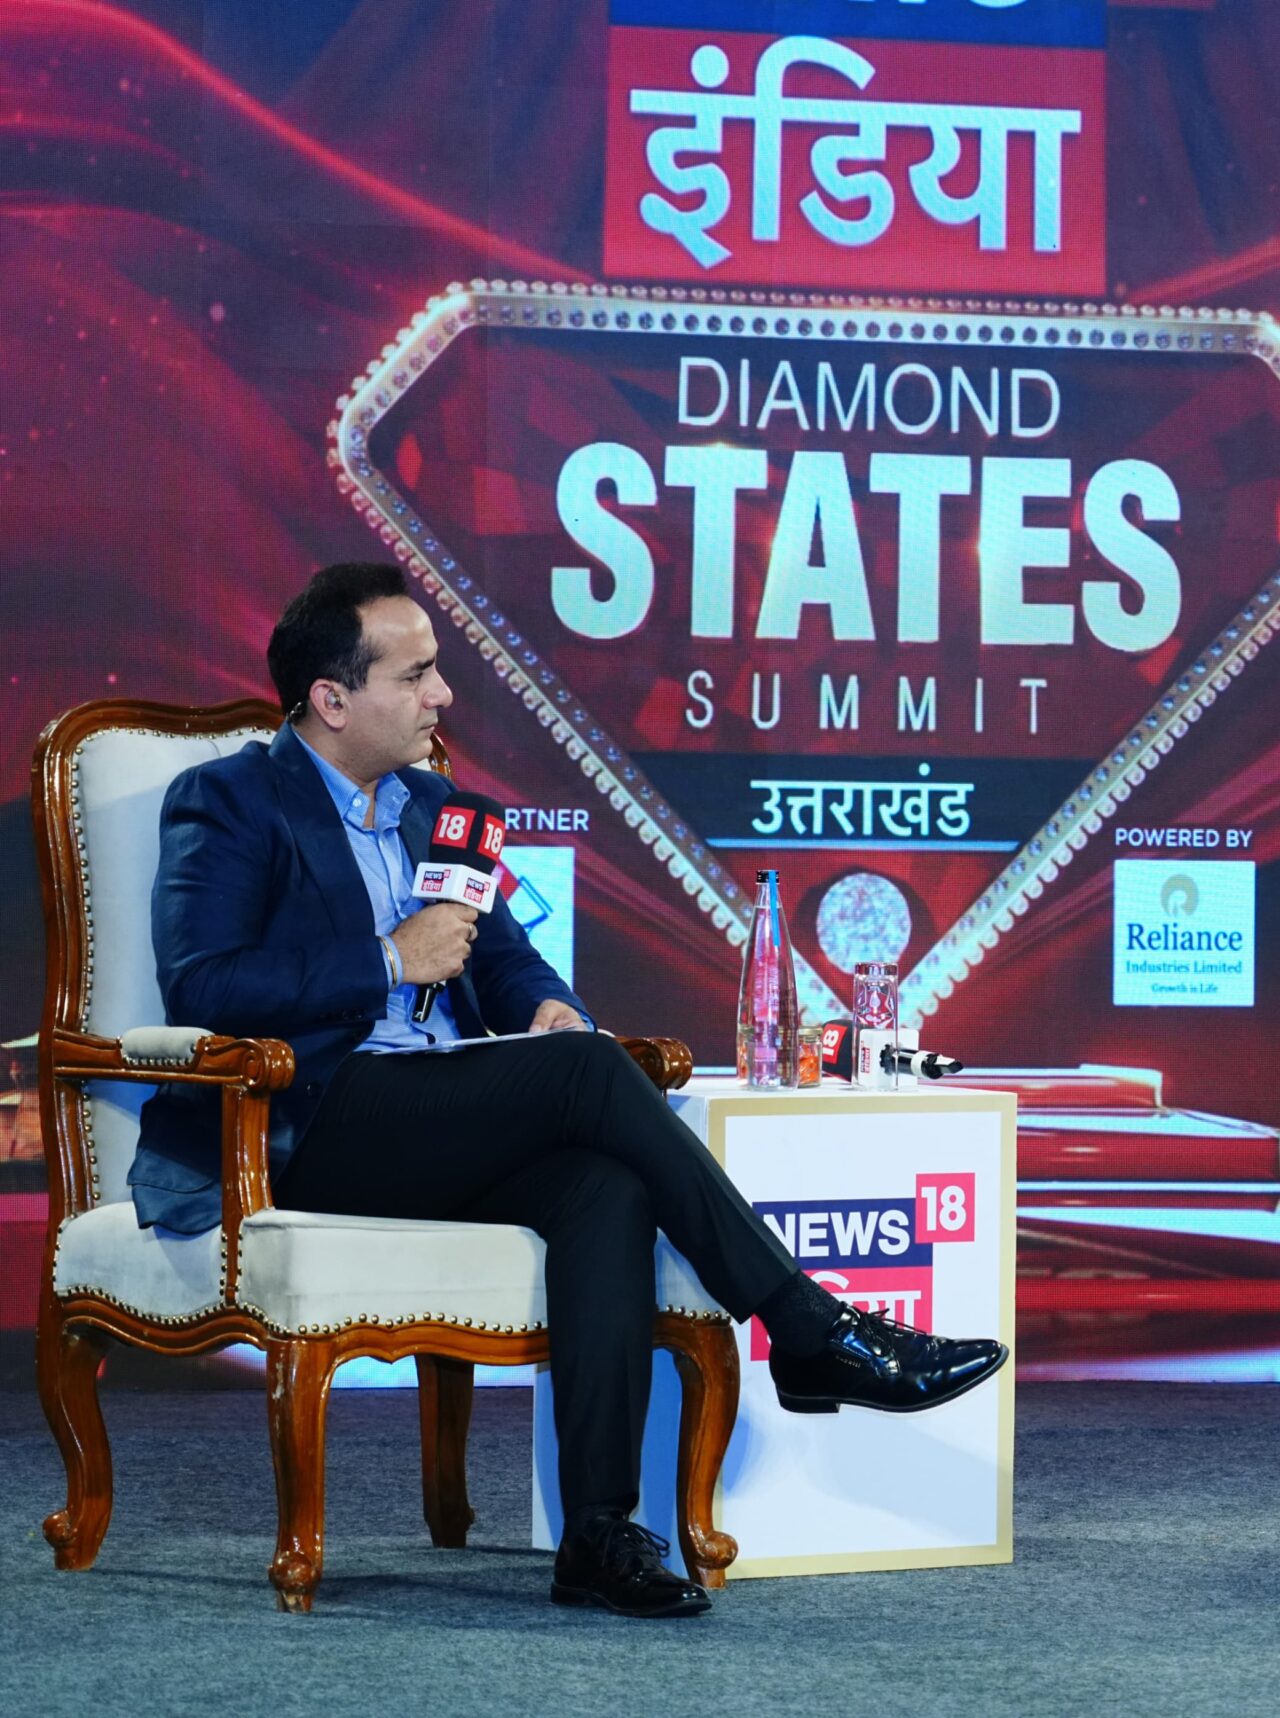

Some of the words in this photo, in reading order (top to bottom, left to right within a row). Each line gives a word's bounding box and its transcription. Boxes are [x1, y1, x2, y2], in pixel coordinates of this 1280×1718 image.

[629, 35, 1082, 269] इंडिया
[677, 356, 1061, 437] DIAMOND
[551, 442, 1182, 652] STATES
[685, 670, 1048, 734] SUMMIT
[750, 763, 974, 837] उत्तराखंड
[438, 813, 466, 840] 18
[505, 808, 589, 831] RTNER
[485, 822, 504, 854] 18
[1115, 828, 1220, 847] POWERED
[1226, 829, 1253, 848] BY
[1126, 922, 1243, 951] Reliance
[1126, 960, 1190, 974] Industries
[1194, 960, 1243, 974] Limited
[1151, 983, 1188, 993] Growth
[1200, 983, 1218, 993] Life
[822, 1029, 839, 1056] 18
[763, 1209, 911, 1258] NEWS
[921, 1186, 967, 1232] 18
